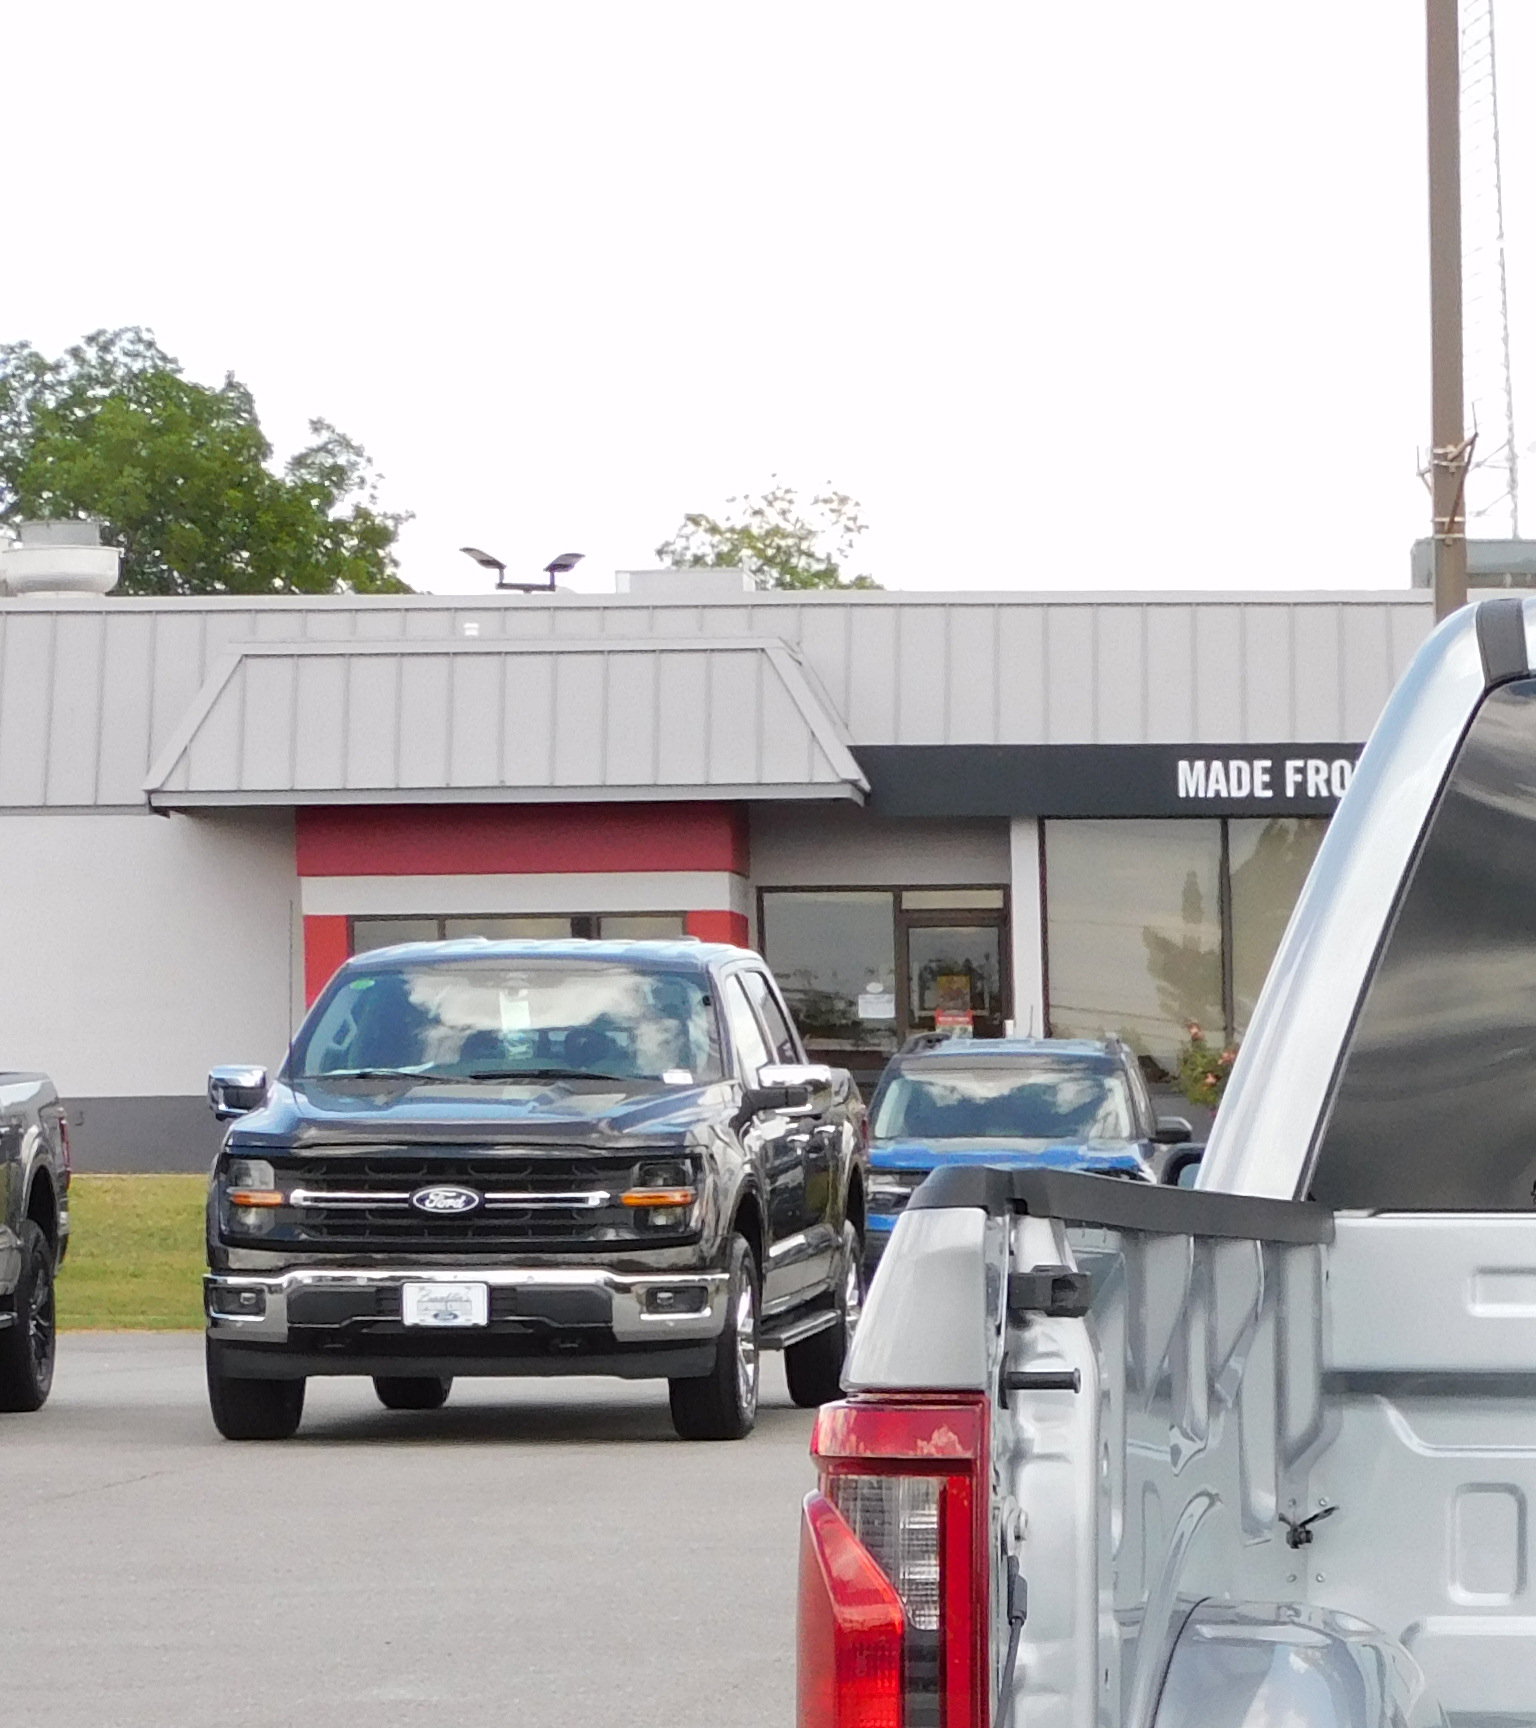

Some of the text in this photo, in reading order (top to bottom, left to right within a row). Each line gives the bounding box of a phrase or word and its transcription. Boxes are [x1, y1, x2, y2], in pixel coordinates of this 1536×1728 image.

[1177, 759, 1356, 798] MADE FRO
[423, 1191, 467, 1209] Ford
